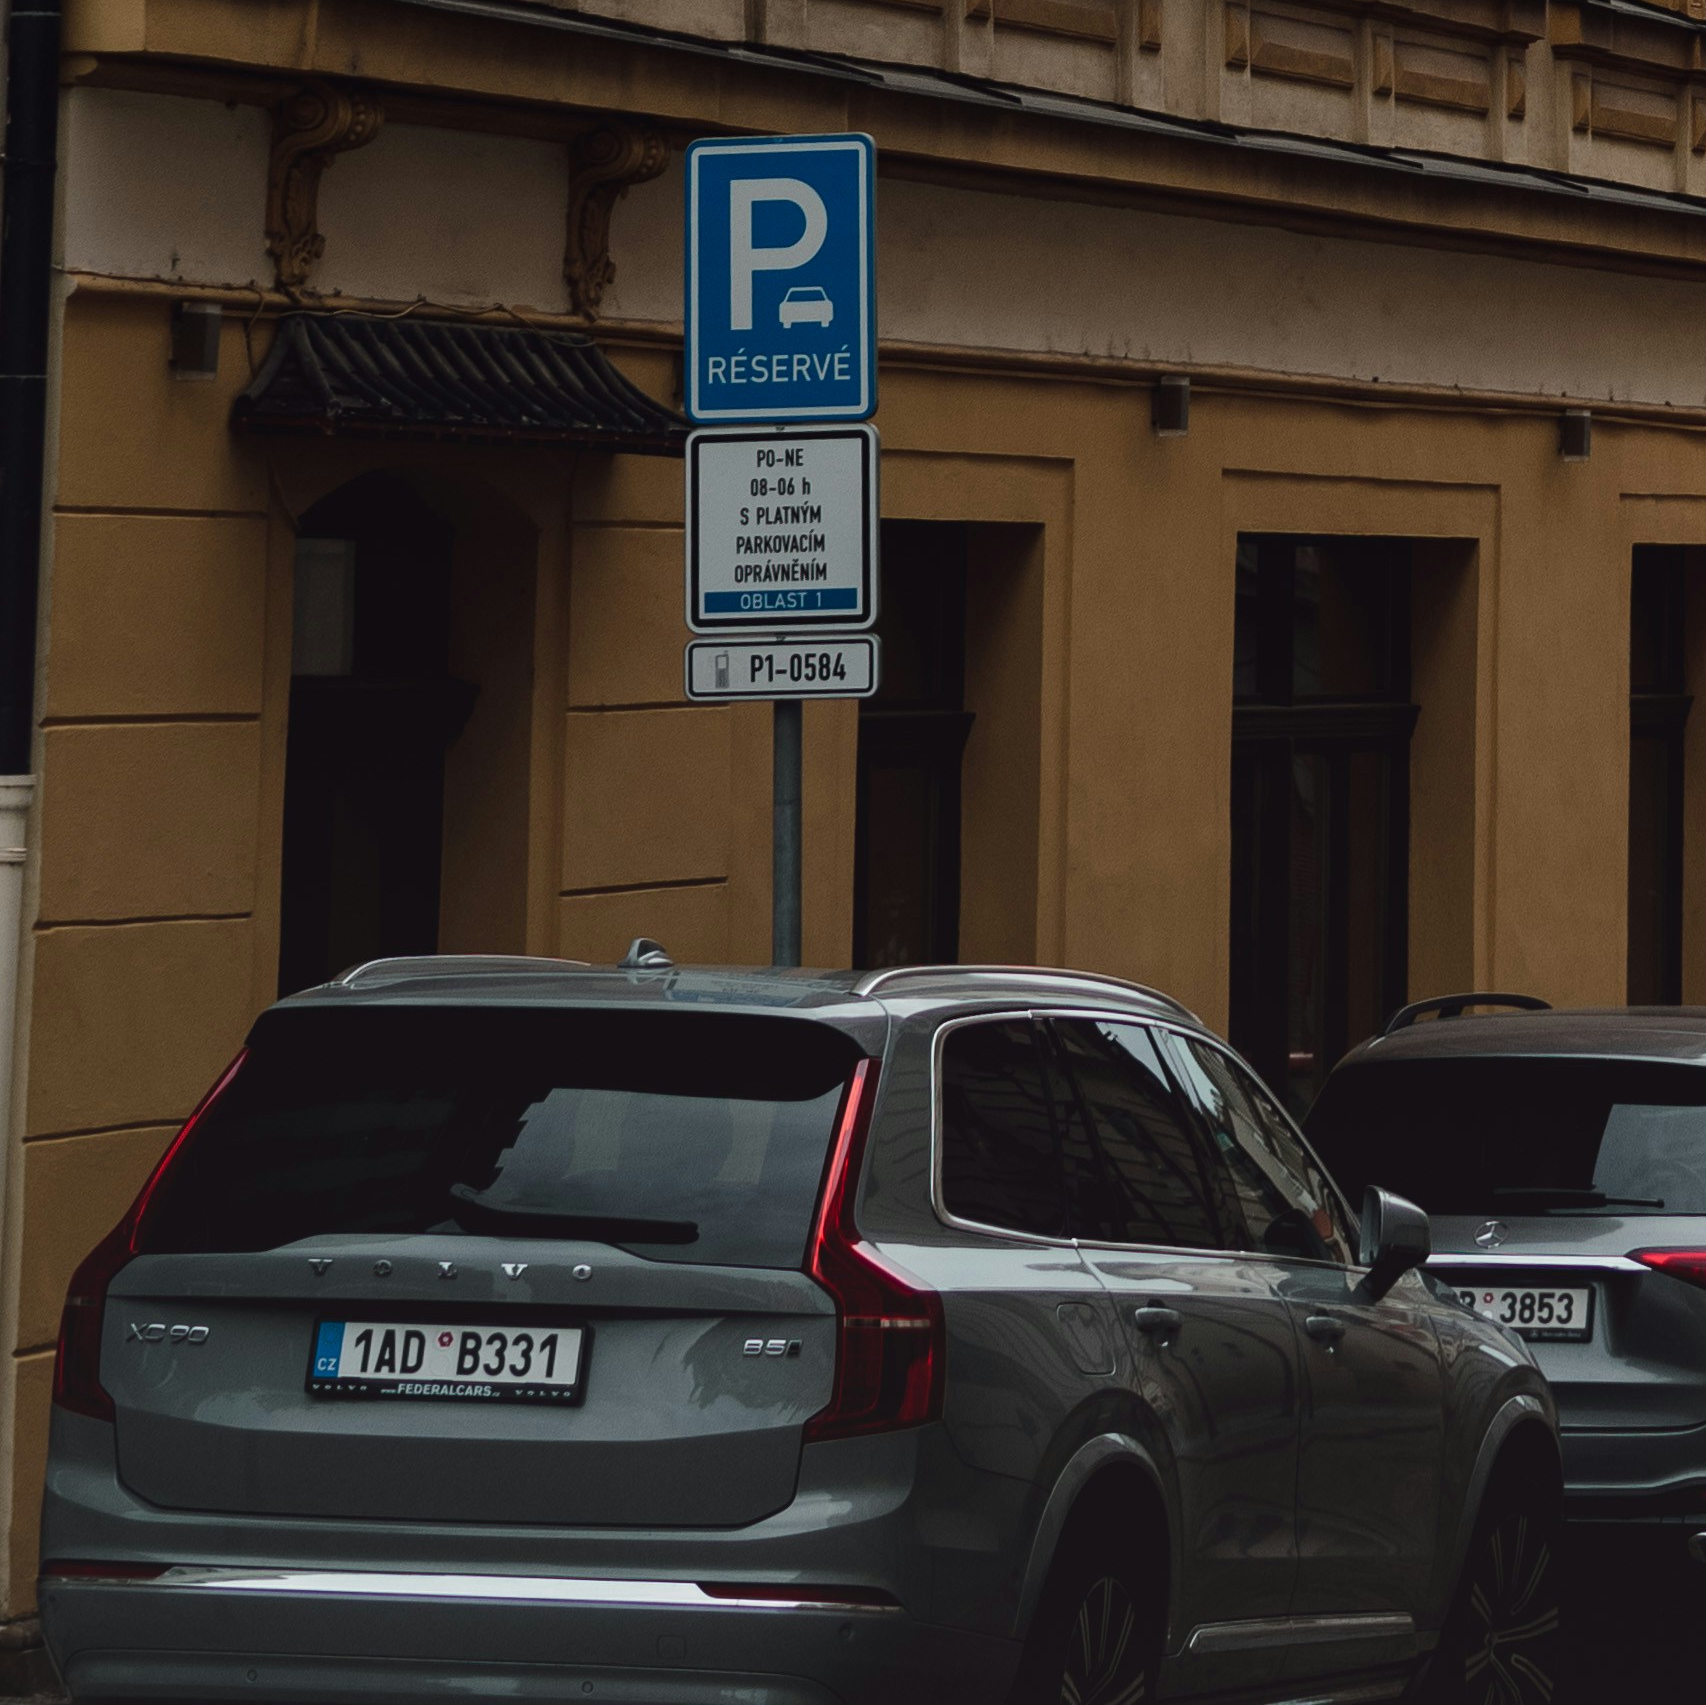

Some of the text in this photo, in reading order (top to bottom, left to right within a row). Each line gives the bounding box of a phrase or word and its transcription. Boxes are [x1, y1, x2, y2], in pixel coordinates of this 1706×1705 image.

[729, 177, 829, 331] P
[708, 344, 852, 385] RÉSERVÉ
[756, 448, 804, 468] PO-NE
[750, 476, 811, 497] 08-06 h
[739, 500, 822, 526] S PLATNÝM
[736, 528, 826, 555] PARKOVACÍM
[734, 556, 828, 584] OPRÁVNĚNÍM
[739, 591, 823, 611] OBLAST 1
[750, 652, 847, 683] P1-0584
[307, 1257, 593, 1281] VOLVO
[1499, 1291, 1574, 1325] 3853
[126, 1322, 211, 1344] XC90
[317, 1357, 338, 1371] CZ
[354, 1328, 560, 1379] 1AD B331
[515, 1389, 572, 1397] VOLVO
